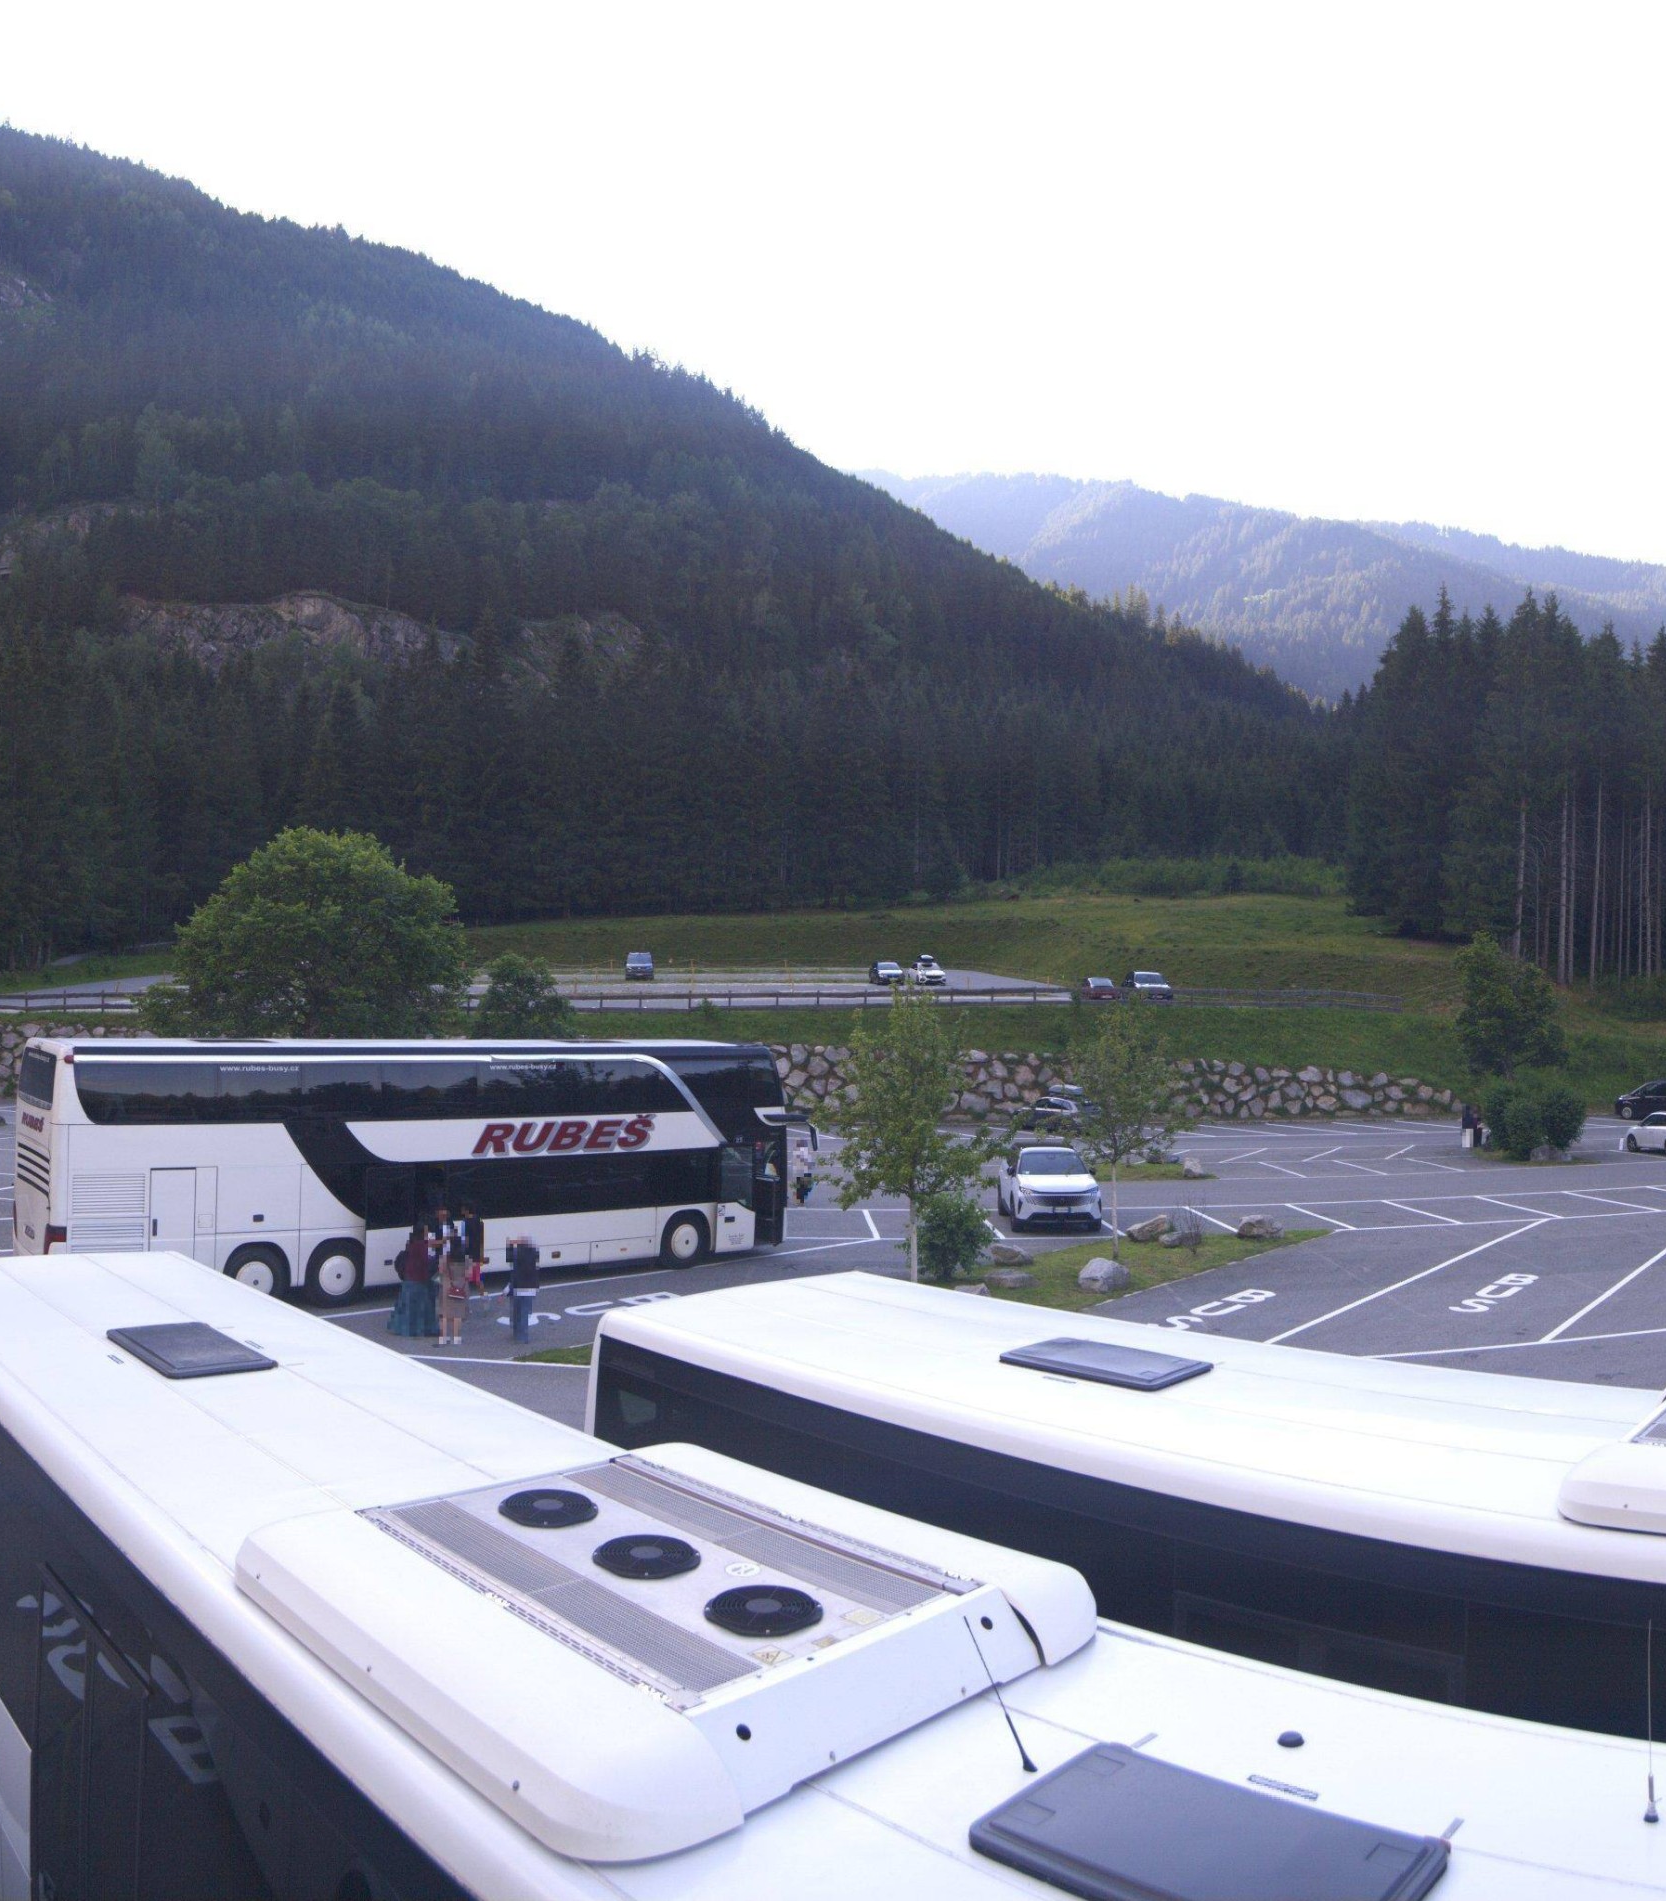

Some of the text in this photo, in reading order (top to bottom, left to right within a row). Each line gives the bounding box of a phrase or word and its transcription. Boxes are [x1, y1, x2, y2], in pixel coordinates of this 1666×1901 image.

[471, 1113, 656, 1158] RUBEŠ
[1146, 1288, 1277, 1333] BUS
[1448, 1273, 1540, 1313] BUS
